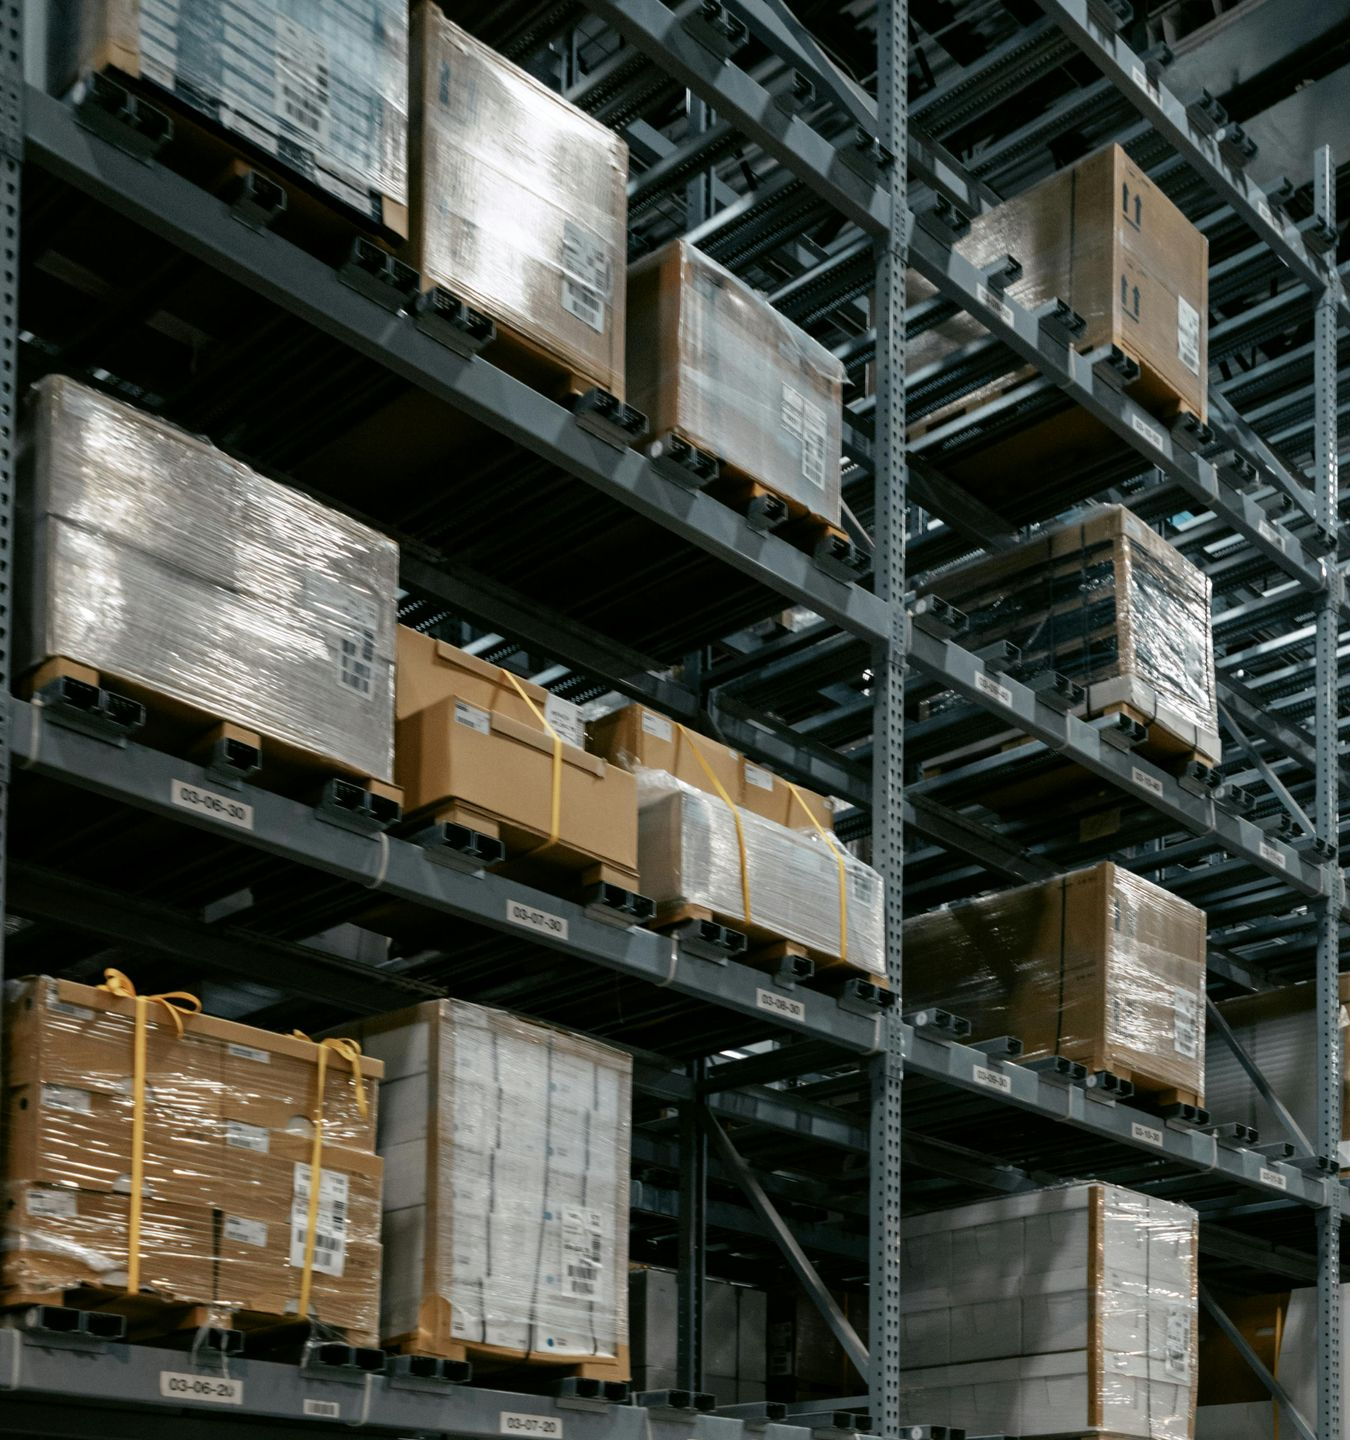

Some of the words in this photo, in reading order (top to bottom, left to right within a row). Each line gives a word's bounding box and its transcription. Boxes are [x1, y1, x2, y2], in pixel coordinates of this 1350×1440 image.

[180, 786, 247, 821] 03-06-30
[512, 905, 563, 932] 03-07-30
[761, 993, 801, 1016] 03-08-30
[169, 1377, 235, 1397] 03-06-20
[506, 1417, 556, 1433] 03-07-20
